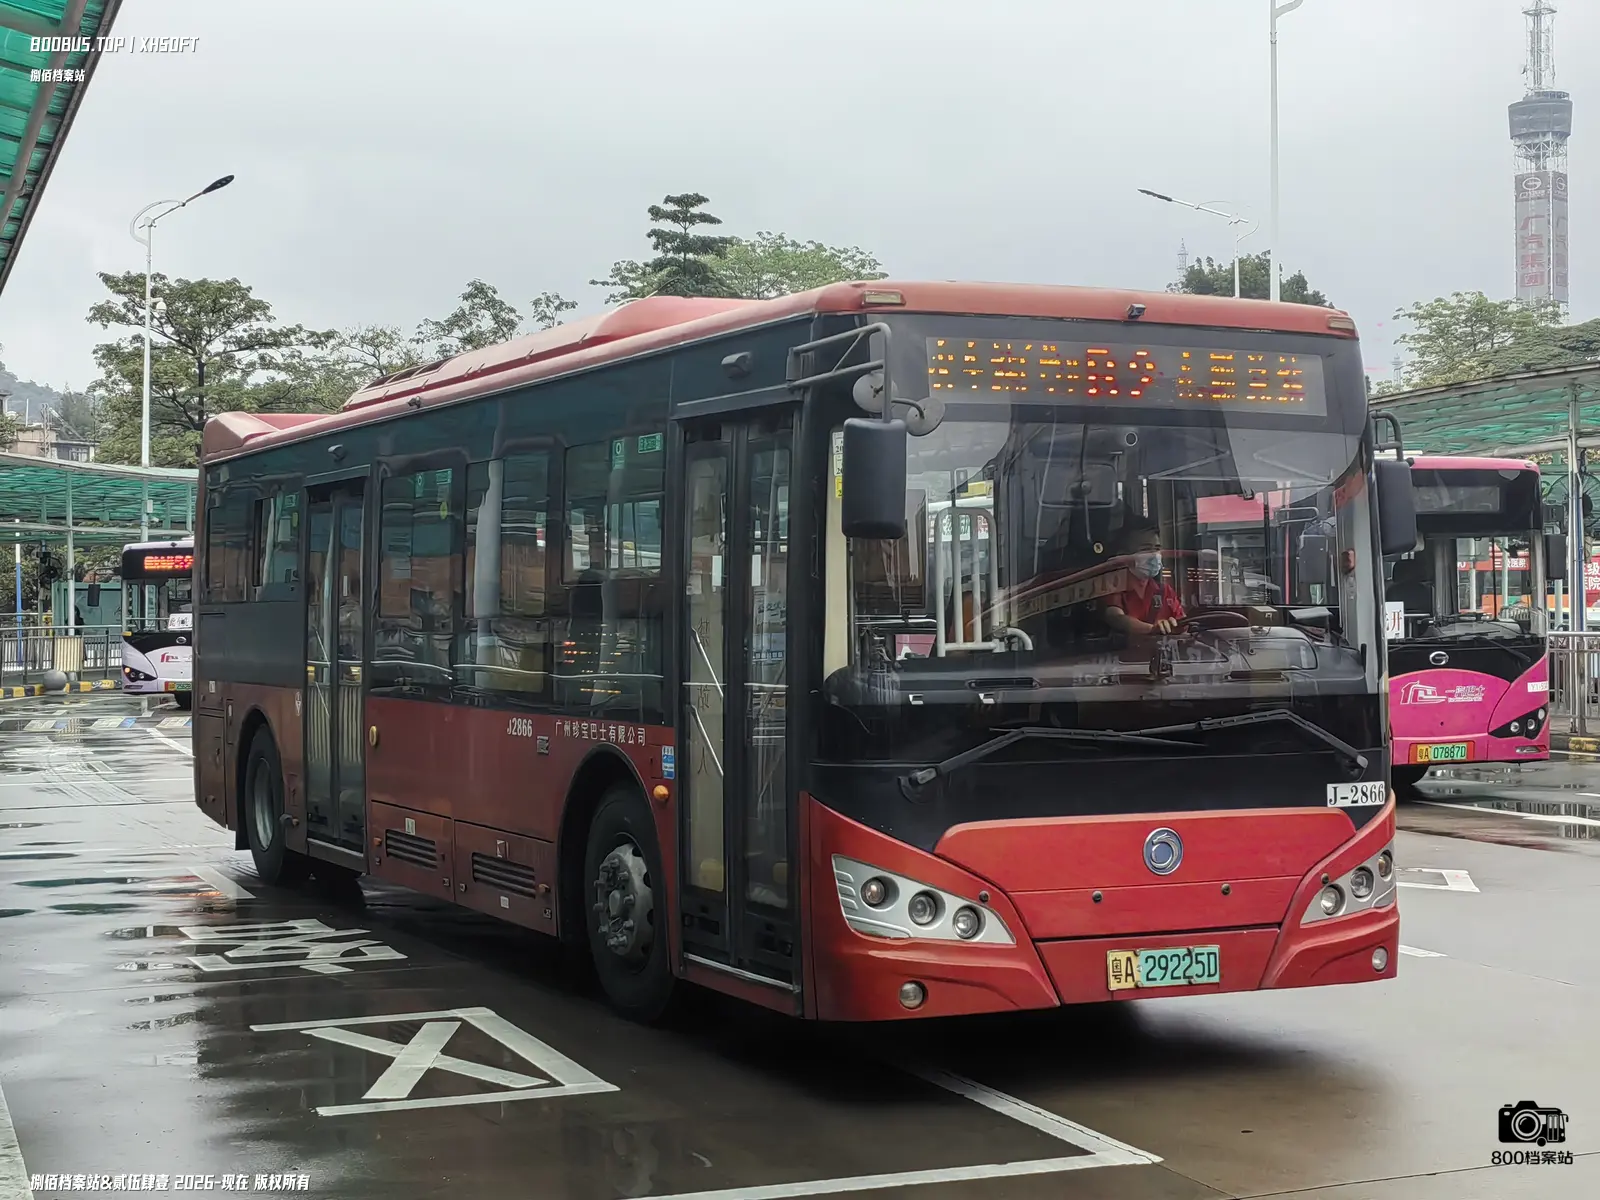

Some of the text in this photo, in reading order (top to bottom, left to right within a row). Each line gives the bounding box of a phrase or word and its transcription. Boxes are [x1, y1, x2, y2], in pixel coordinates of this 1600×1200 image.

[507, 717, 532, 737] J2866
[555, 720, 646, 746] 广州珍宝巴士有限公司
[1328, 784, 1384, 805] J-2866
